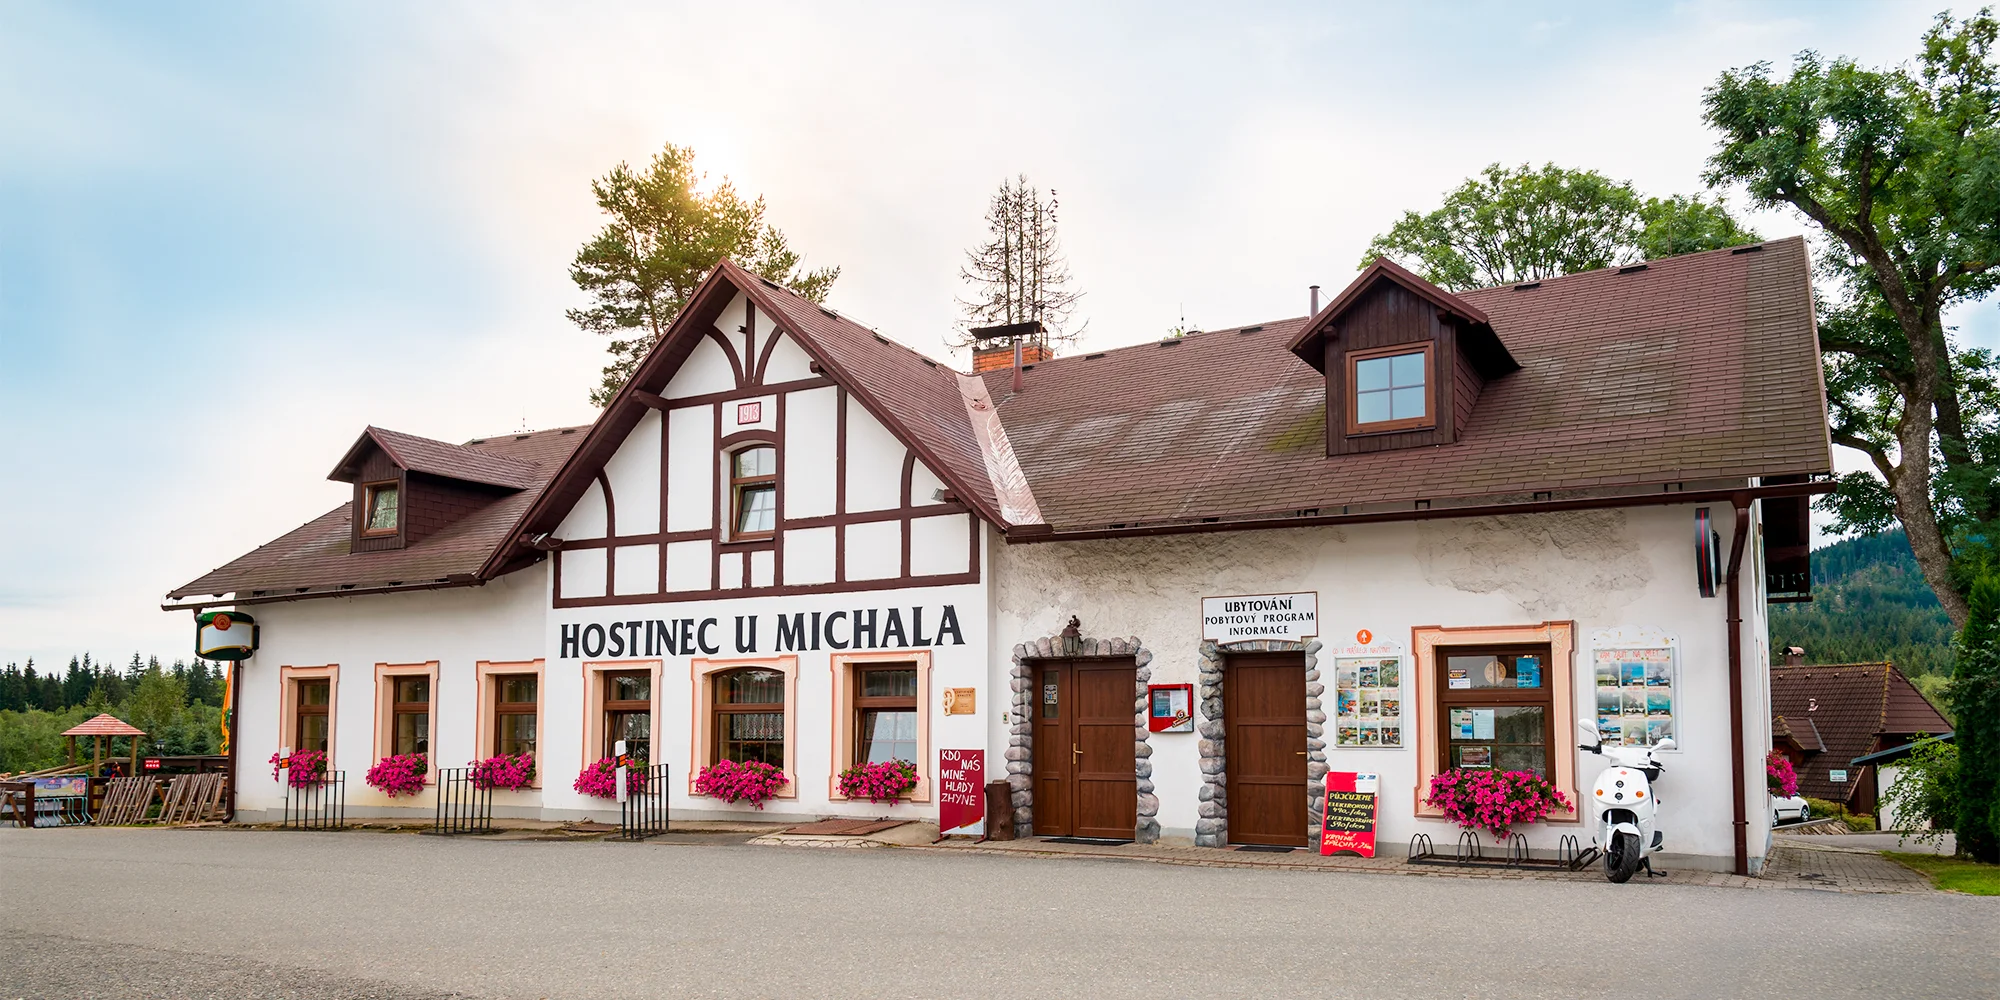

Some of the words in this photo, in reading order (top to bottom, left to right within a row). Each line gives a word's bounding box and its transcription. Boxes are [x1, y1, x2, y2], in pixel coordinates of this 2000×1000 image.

[739, 404, 759, 422] 1913
[1225, 597, 1293, 612] UBYTOVÁNÍ
[1205, 613, 1257, 625] POBYTOVÝ
[1263, 612, 1315, 623] PROGRAM
[560, 618, 720, 658] HOSTINEC
[735, 615, 758, 653] U
[775, 605, 966, 651] MICHALA
[1229, 625, 1289, 636] INFORMACE
[941, 750, 961, 761] KDO
[961, 754, 981, 771] NÁS
[941, 769, 967, 781] MINE,
[945, 781, 974, 793] HLADY
[941, 793, 976, 806] ZHYNE
